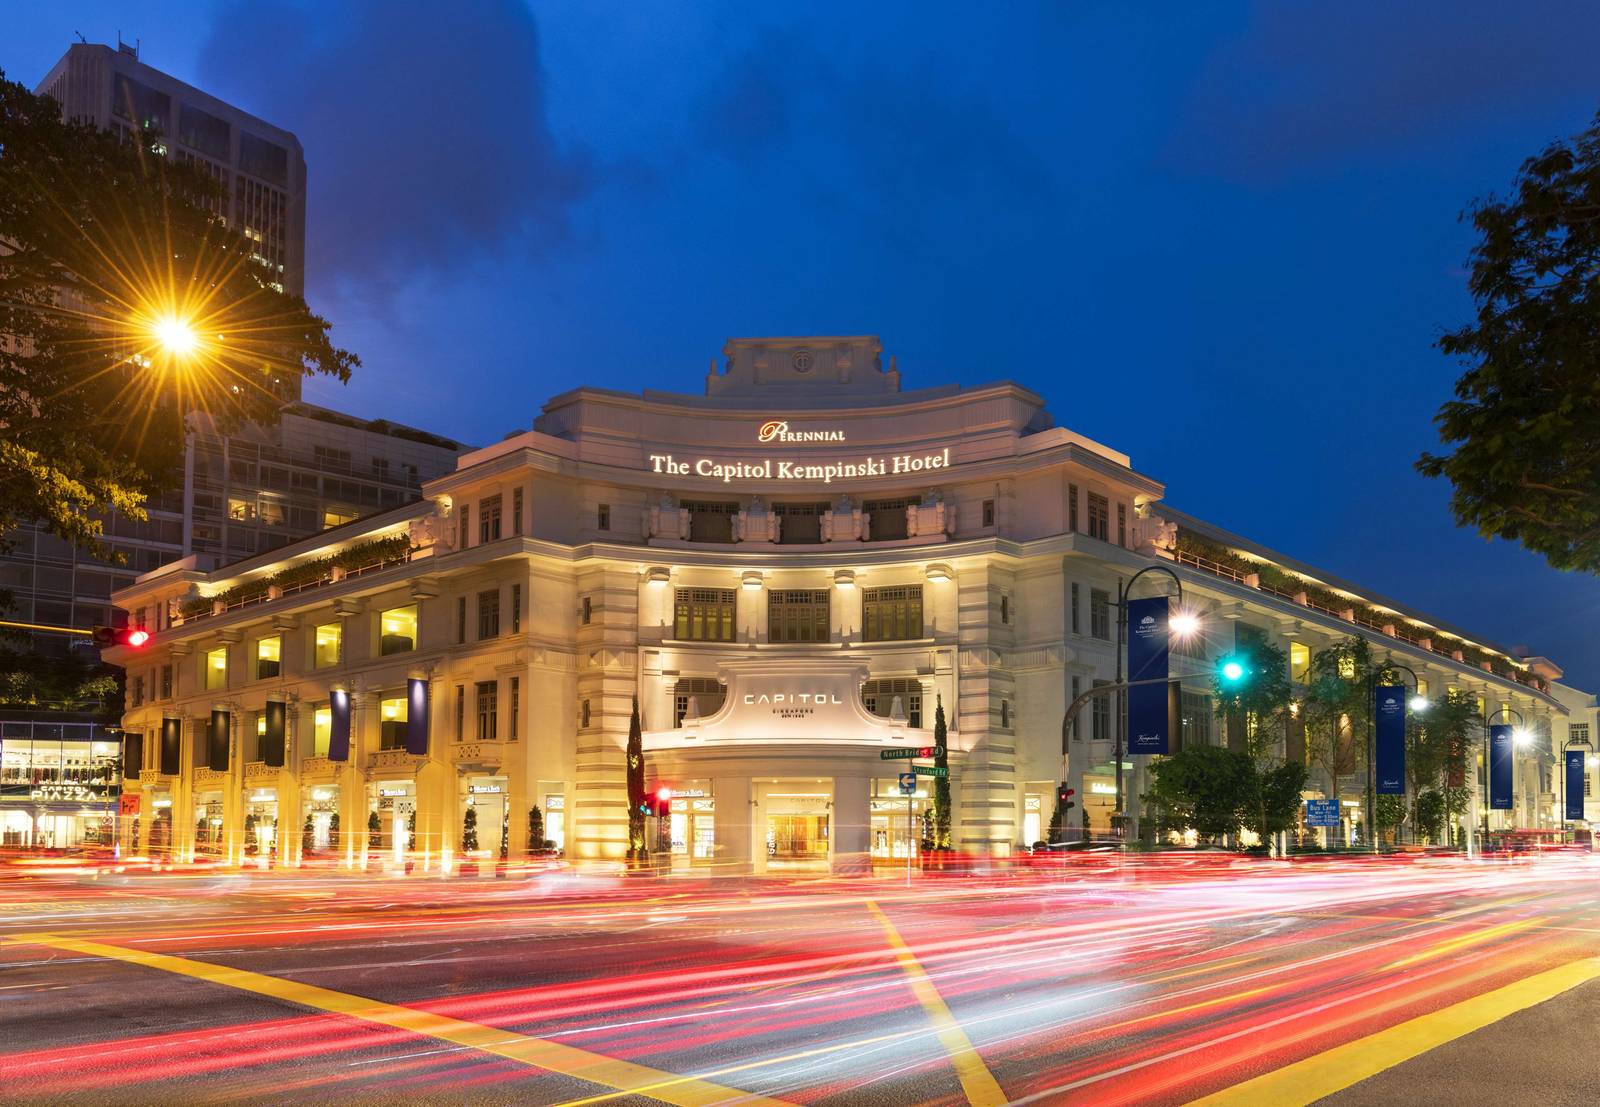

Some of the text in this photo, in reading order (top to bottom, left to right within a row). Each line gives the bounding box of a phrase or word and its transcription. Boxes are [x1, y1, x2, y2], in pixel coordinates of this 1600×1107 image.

[758, 421, 846, 442] PERENNIAL
[650, 448, 950, 483] The Capitol Kempinski Hotel
[744, 694, 842, 704] CAPITOL
[883, 749, 903, 758] North
[930, 747, 939, 755] Rd
[939, 768, 946, 776] Rd
[31, 791, 97, 800] PIAZZA
